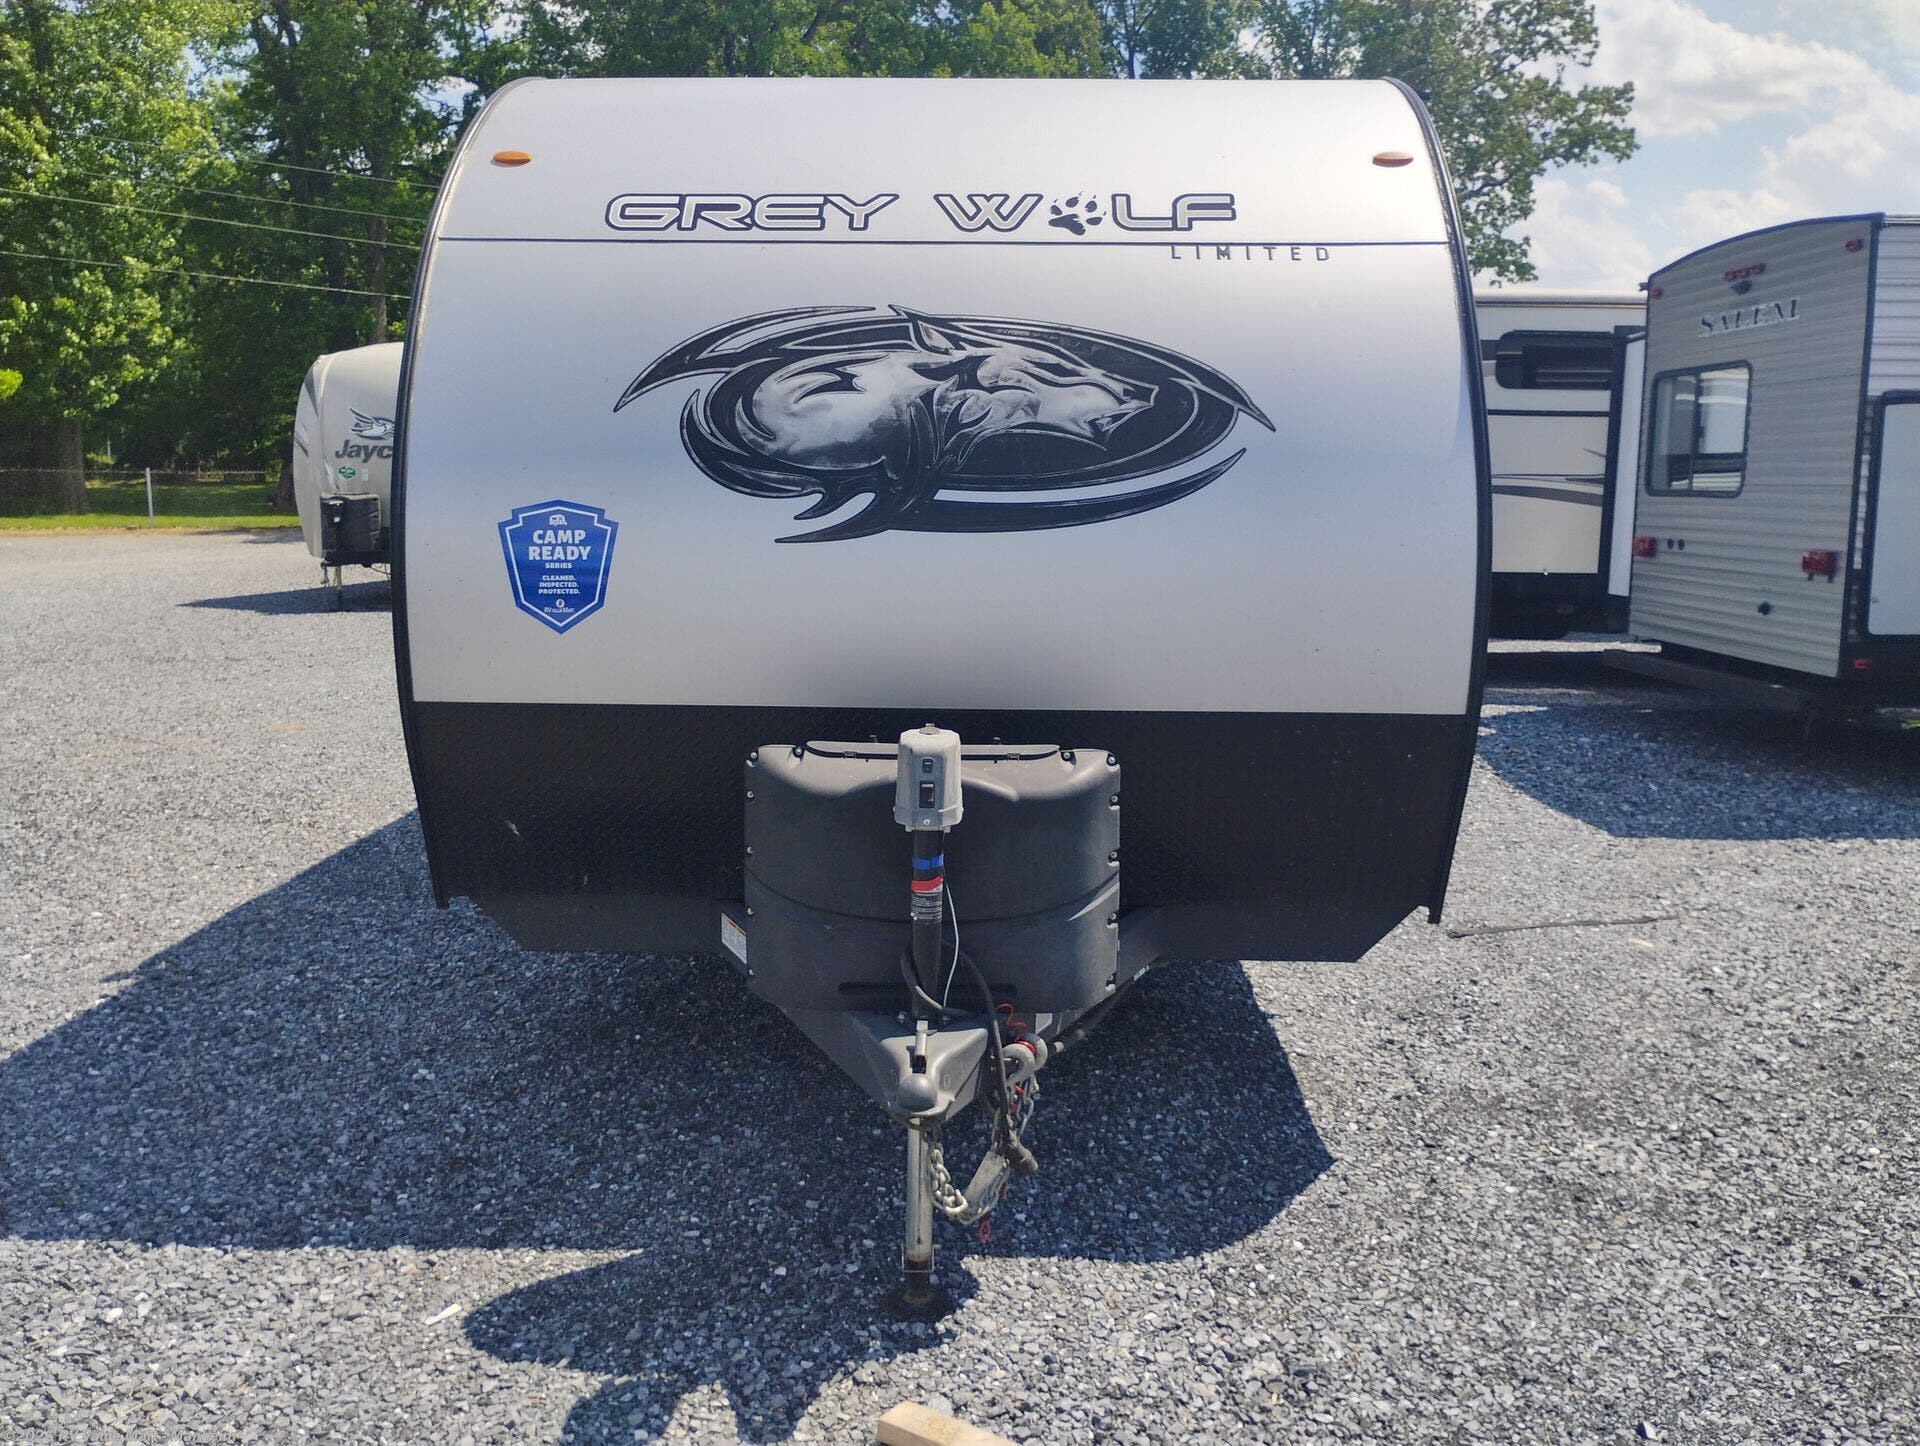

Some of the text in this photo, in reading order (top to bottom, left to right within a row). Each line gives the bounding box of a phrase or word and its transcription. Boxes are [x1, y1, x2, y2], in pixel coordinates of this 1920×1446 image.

[605, 193, 900, 231] GREY
[1171, 245, 1330, 262] LIMITED
[1697, 297, 1799, 338] SALEM
[532, 529, 586, 544] CAMP
[528, 546, 591, 561] READY
